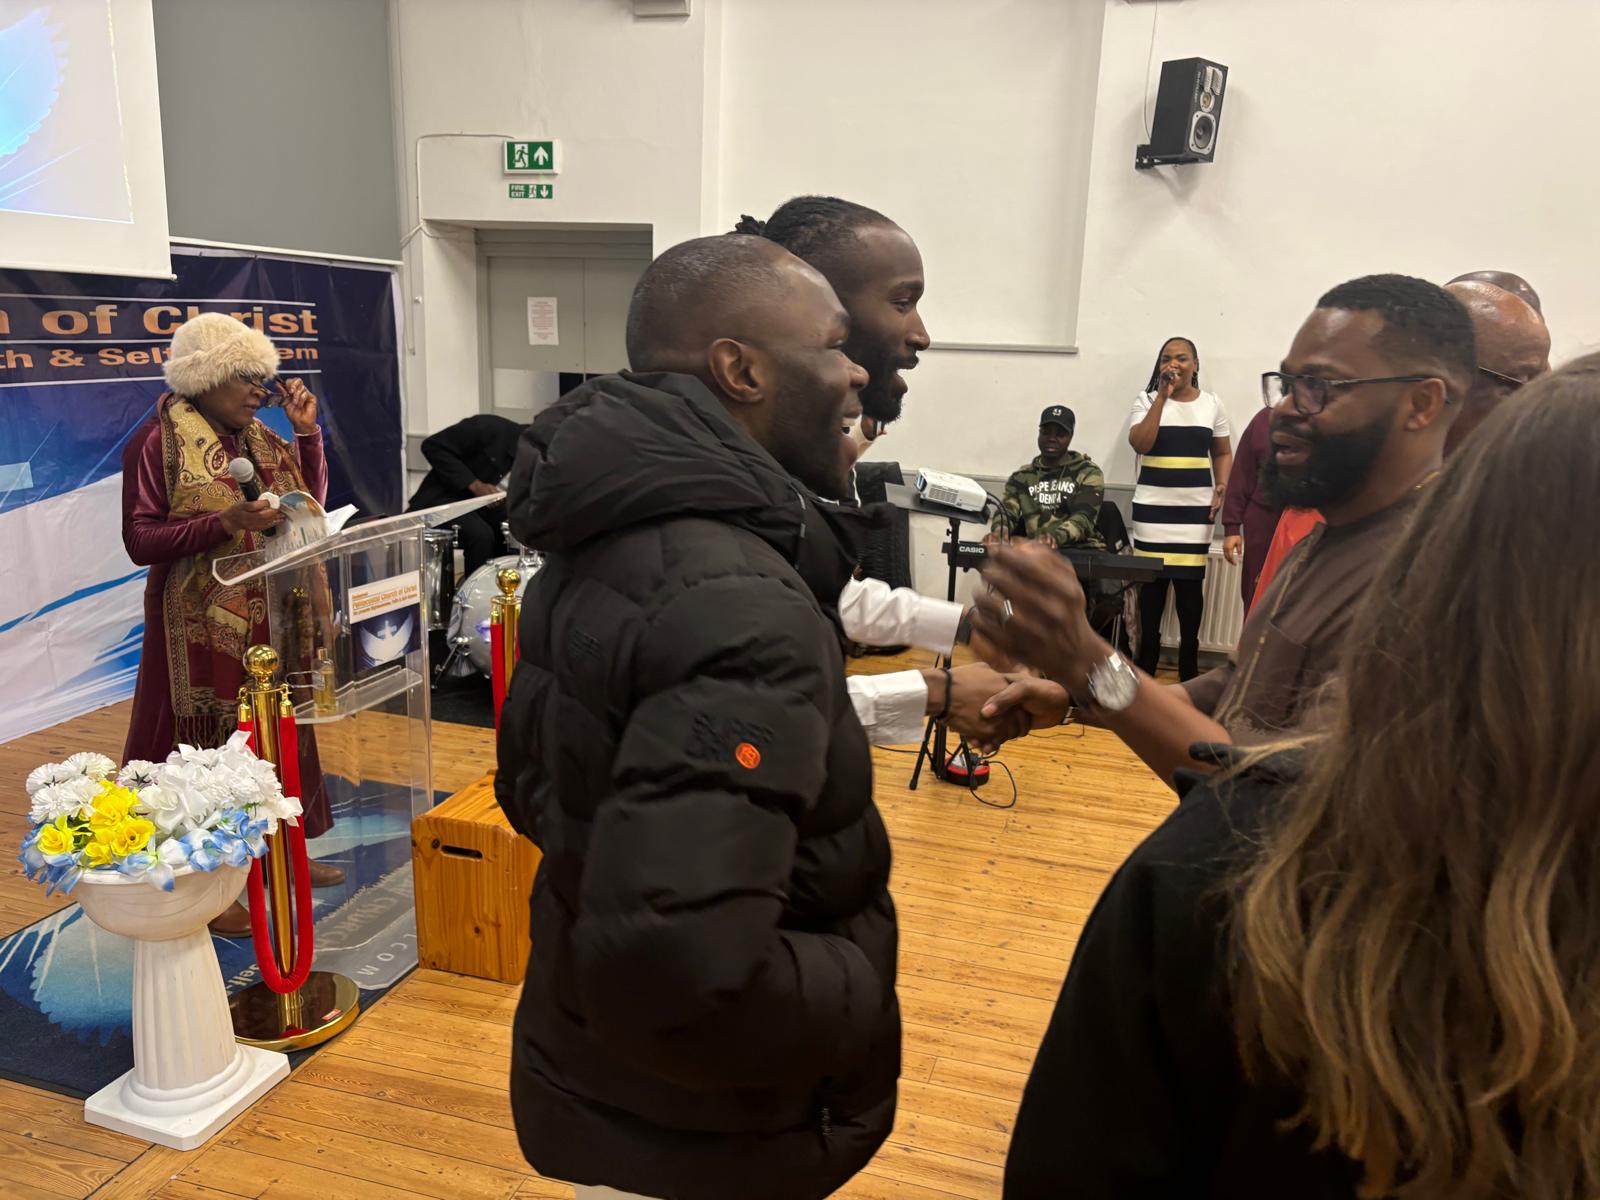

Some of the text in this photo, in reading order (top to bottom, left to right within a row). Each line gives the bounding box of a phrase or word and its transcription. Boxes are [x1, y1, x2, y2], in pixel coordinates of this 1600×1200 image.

[42, 304, 117, 335] of
[49, 349, 85, 367] &
[959, 546, 984, 554] CASIO
